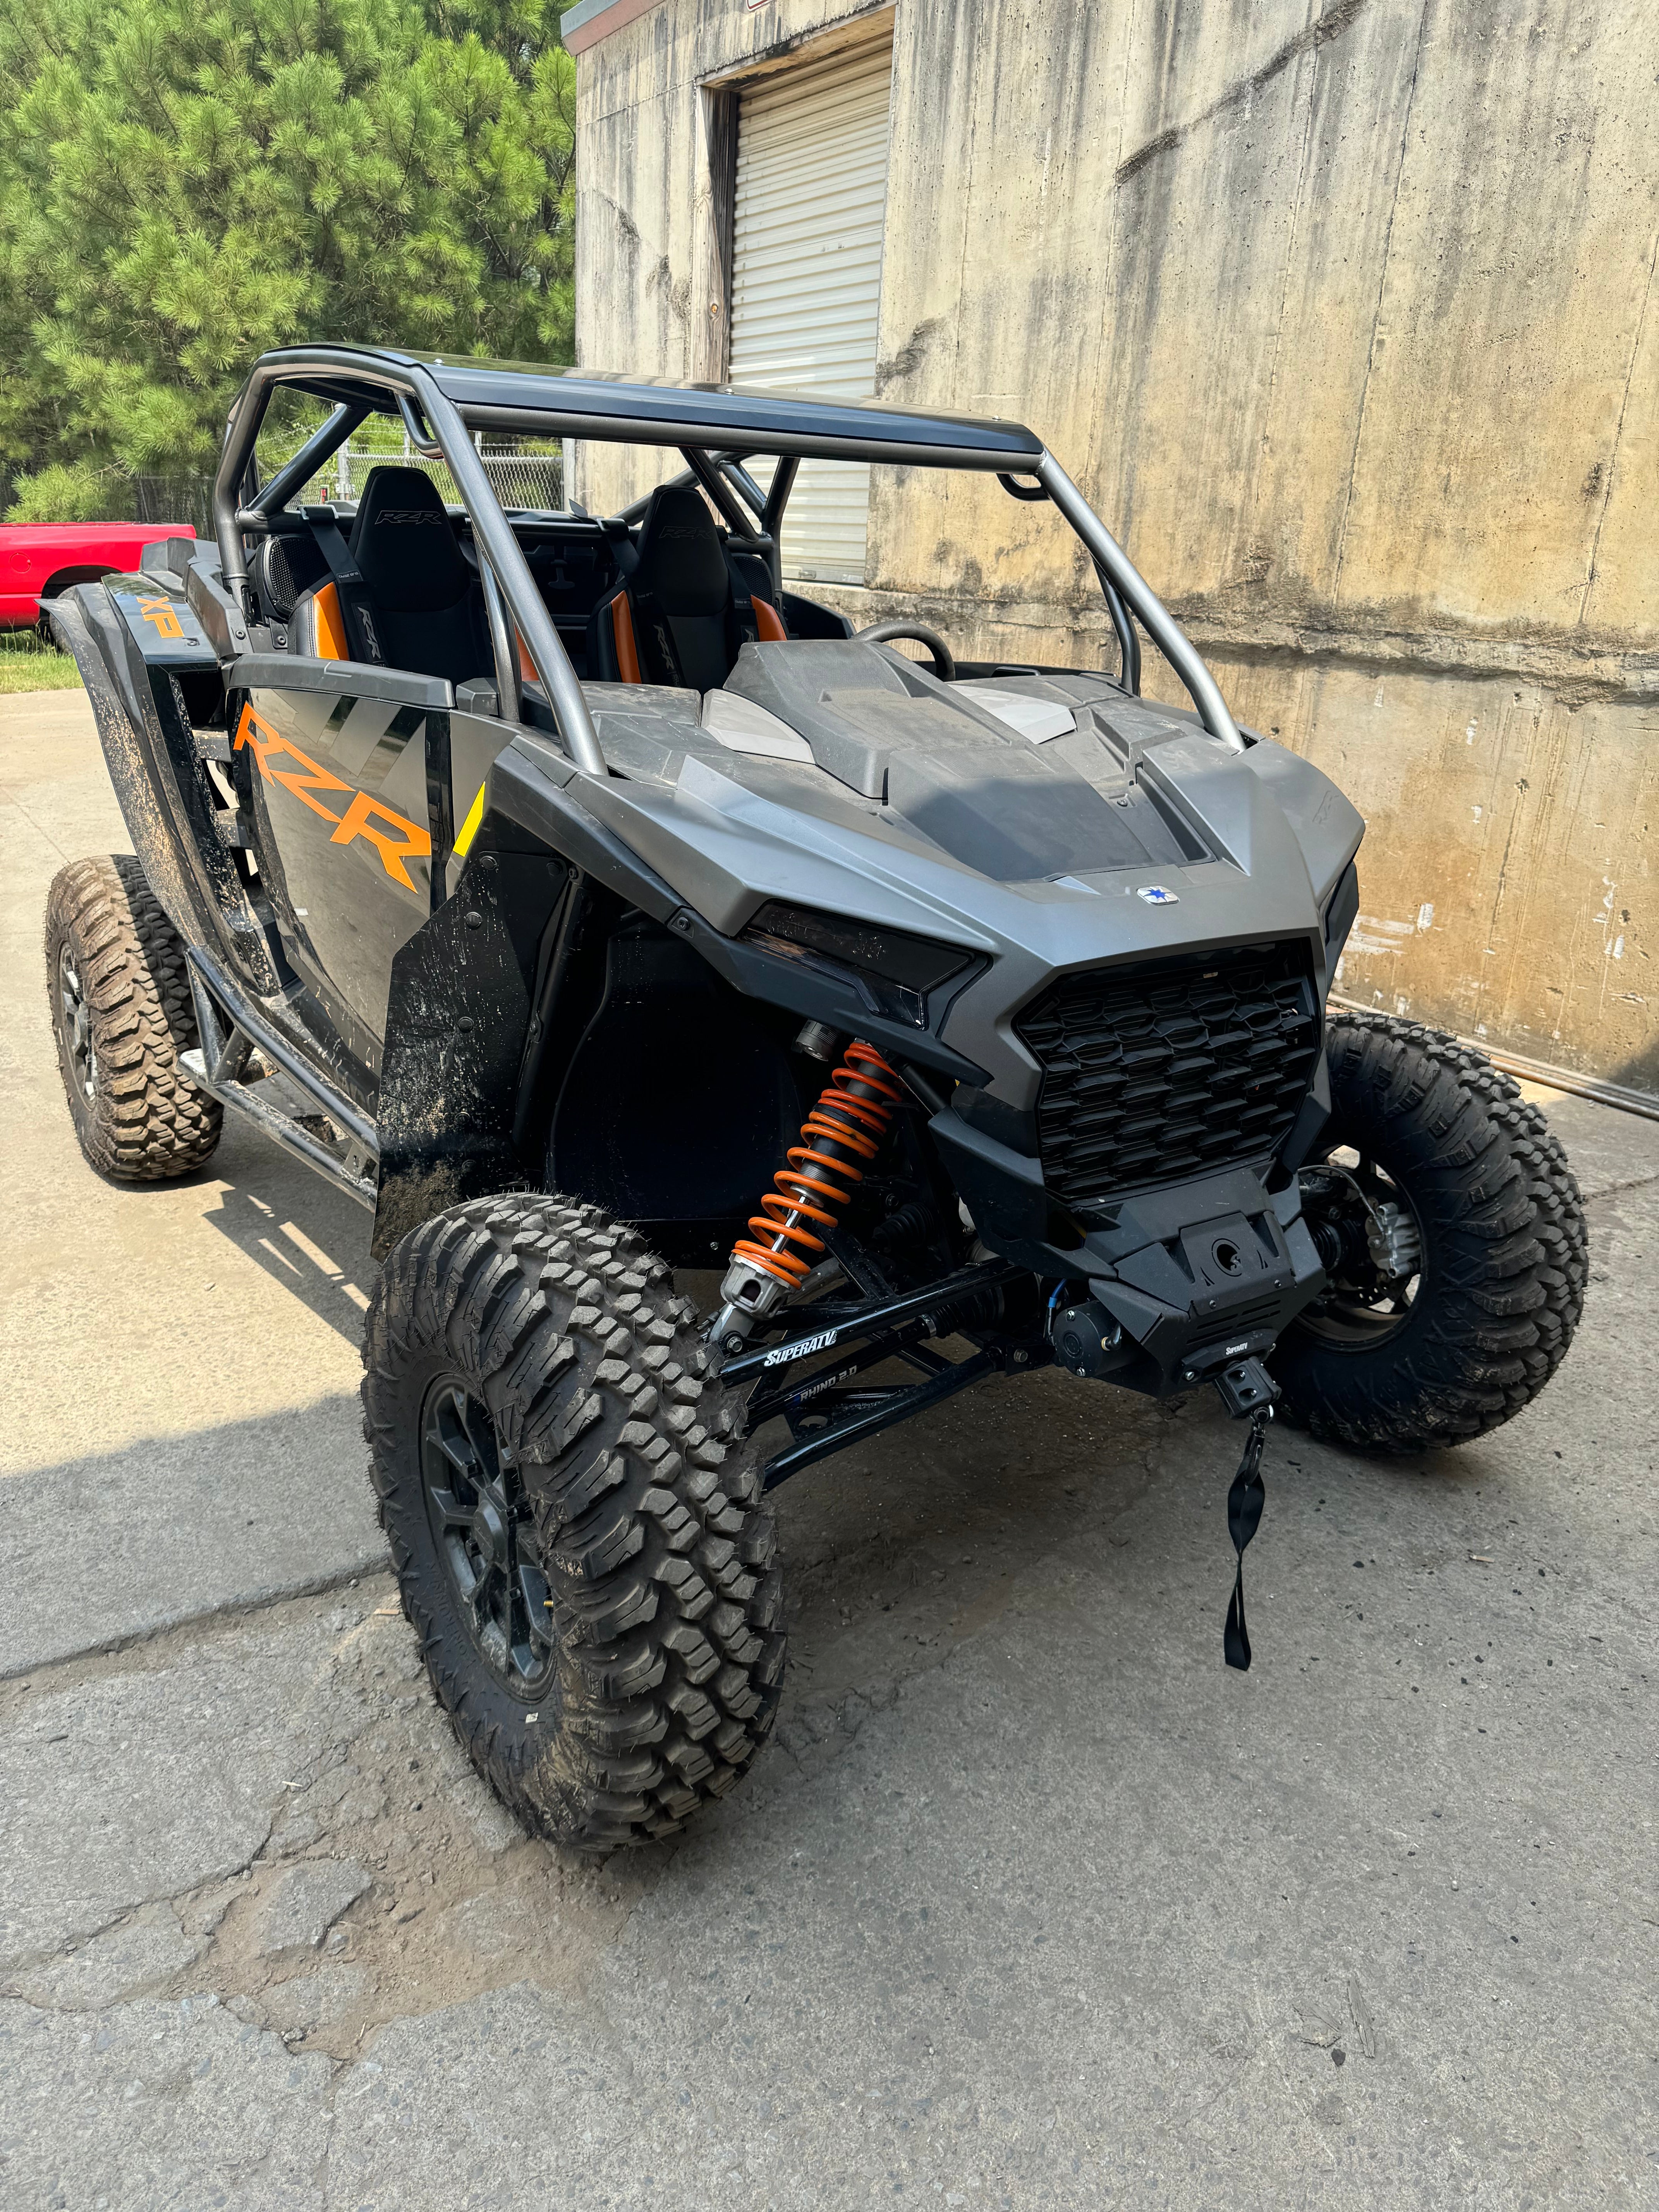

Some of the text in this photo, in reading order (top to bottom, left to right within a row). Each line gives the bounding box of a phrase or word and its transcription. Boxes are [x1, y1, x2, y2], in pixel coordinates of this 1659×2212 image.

[374, 510, 442, 525] RZR
[659, 526, 713, 539] RZR
[136, 596, 185, 638] XP
[357, 607, 381, 659] RZR
[653, 625, 674, 670] RZR
[233, 701, 431, 894] RZR
[800, 1365, 857, 1402] RHINO 2.0
